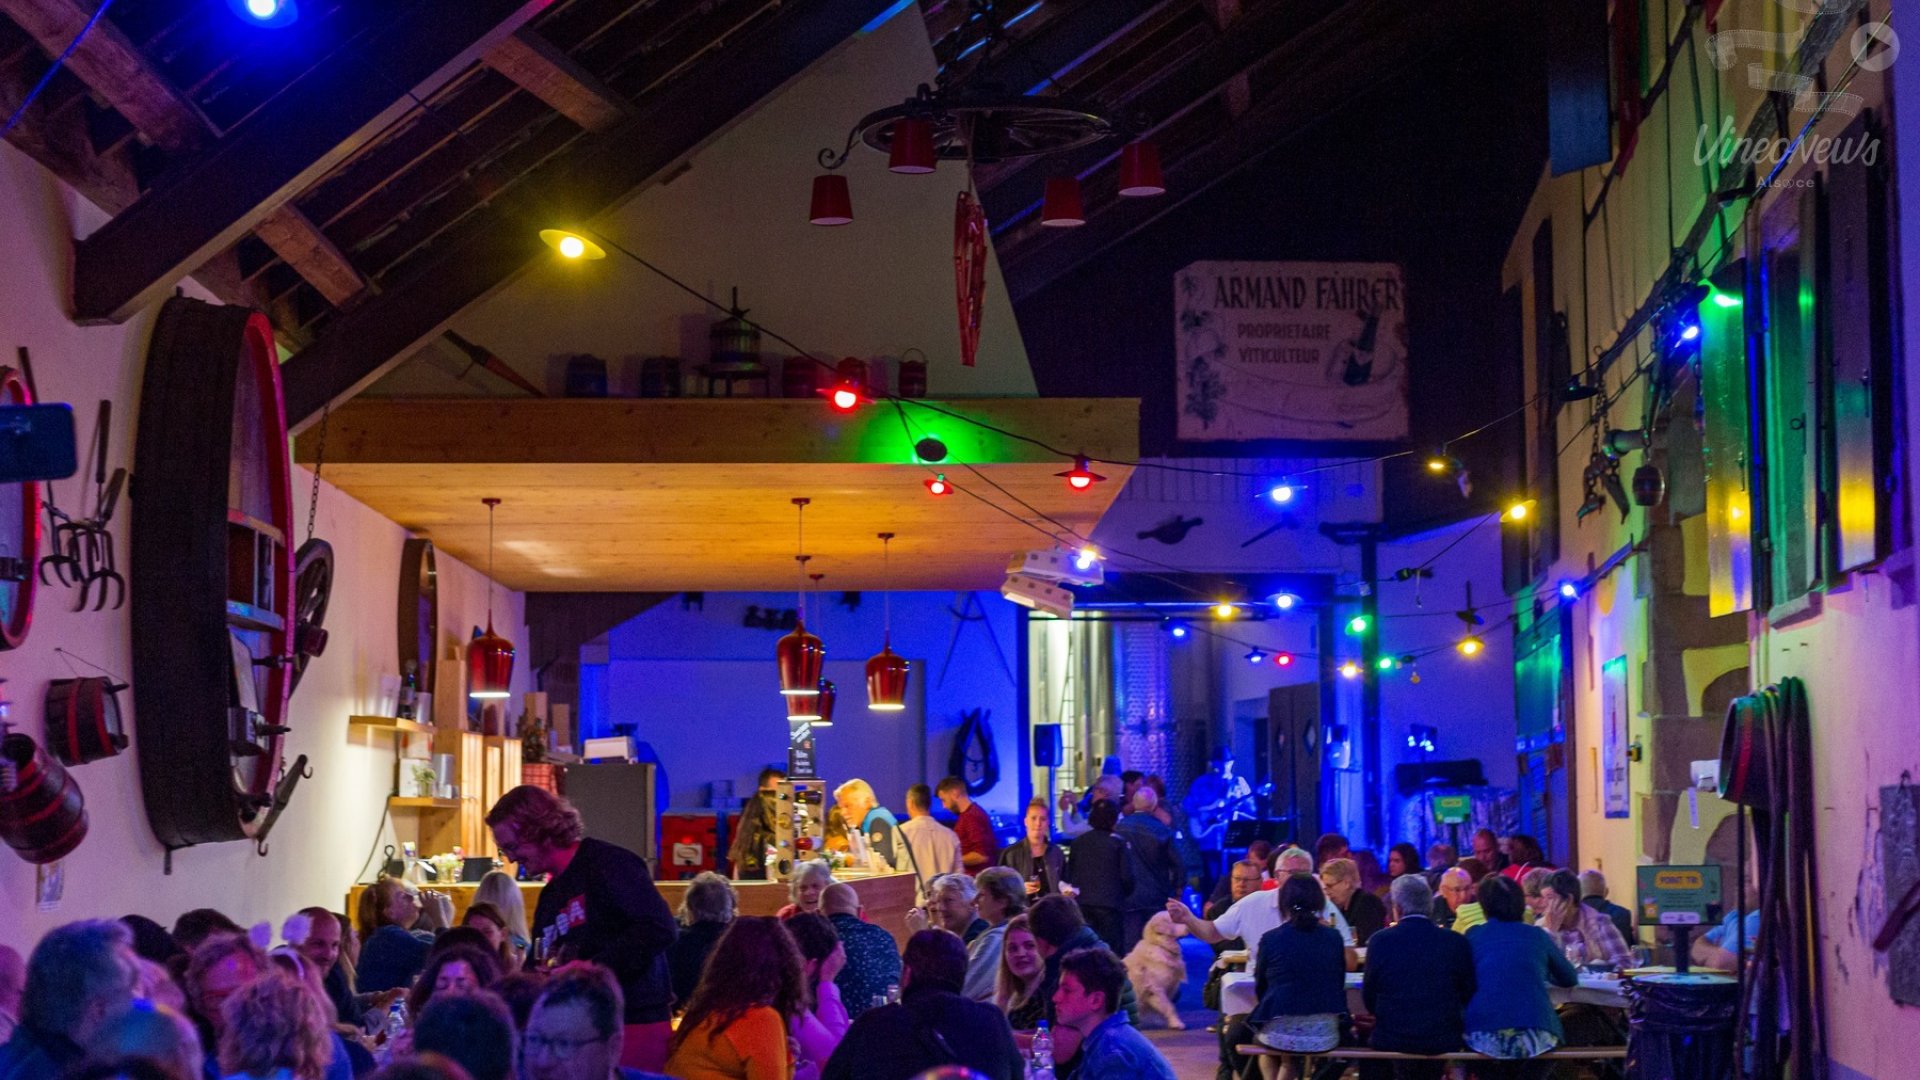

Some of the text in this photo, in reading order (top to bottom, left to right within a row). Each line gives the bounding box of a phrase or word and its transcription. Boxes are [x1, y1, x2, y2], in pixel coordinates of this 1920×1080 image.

[1214, 275, 1400, 311] ARMAND FAHRER
[1237, 322, 1331, 341] PROPRIETAIRE
[1239, 347, 1320, 364] VITICULTEUR
